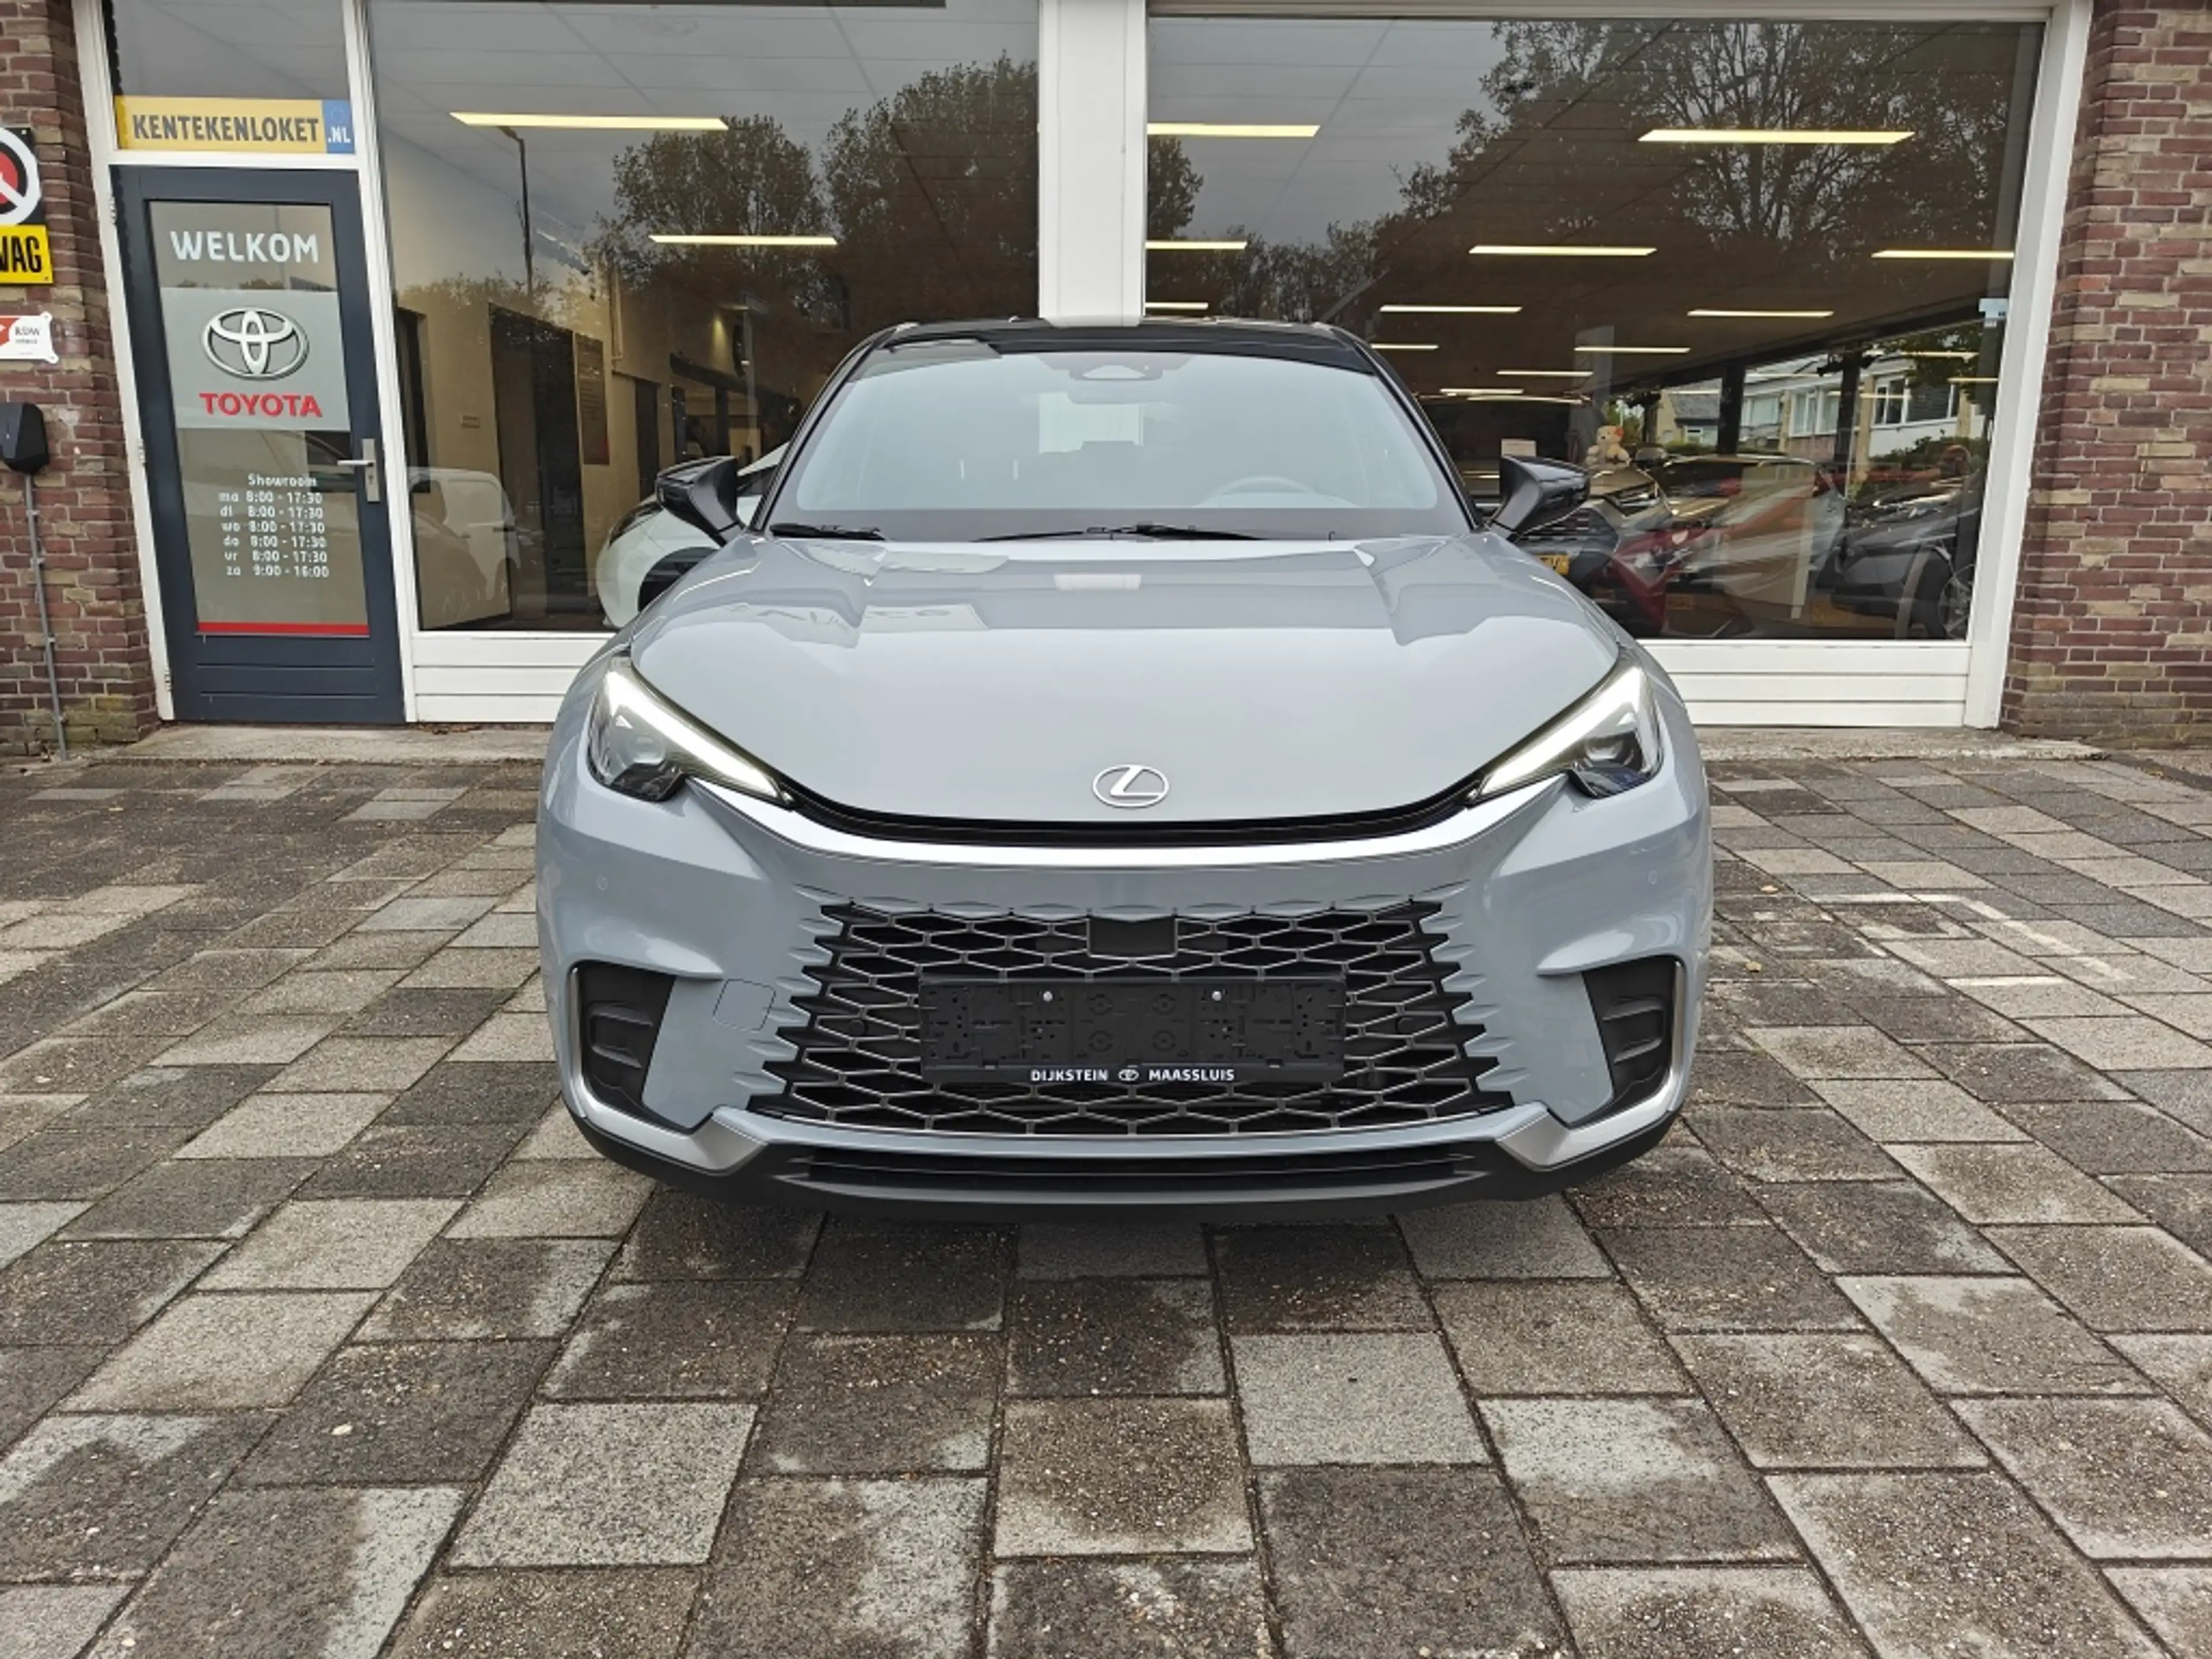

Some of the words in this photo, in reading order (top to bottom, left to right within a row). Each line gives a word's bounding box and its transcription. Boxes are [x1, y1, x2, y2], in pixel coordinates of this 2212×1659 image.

[132, 115, 319, 143] KENTEKENLOKET
[327, 126, 351, 144] .NL
[170, 230, 319, 263] WELKOM
[199, 392, 323, 418] TOYOTA
[248, 473, 317, 487] Showroom
[218, 492, 239, 502] ma
[246, 491, 274, 503] 8:00
[287, 492, 323, 504] 17:30
[220, 505, 233, 517] di
[248, 505, 275, 517] 8:00
[289, 507, 324, 518] 17:30
[221, 522, 240, 533] wo
[248, 520, 277, 533] 8:00
[289, 521, 325, 533] 17:30
[224, 535, 240, 547] do
[250, 535, 278, 547] 8:00
[291, 536, 327, 548] 17:30
[224, 551, 238, 561] vr
[252, 550, 279, 562] 8:00
[293, 551, 327, 563] 17:30
[226, 565, 241, 576] za
[252, 564, 282, 576] 9:00
[1030, 1069, 1109, 1082] DIJKSTEIN
[1148, 1069, 1235, 1082] MAASSLUIS
